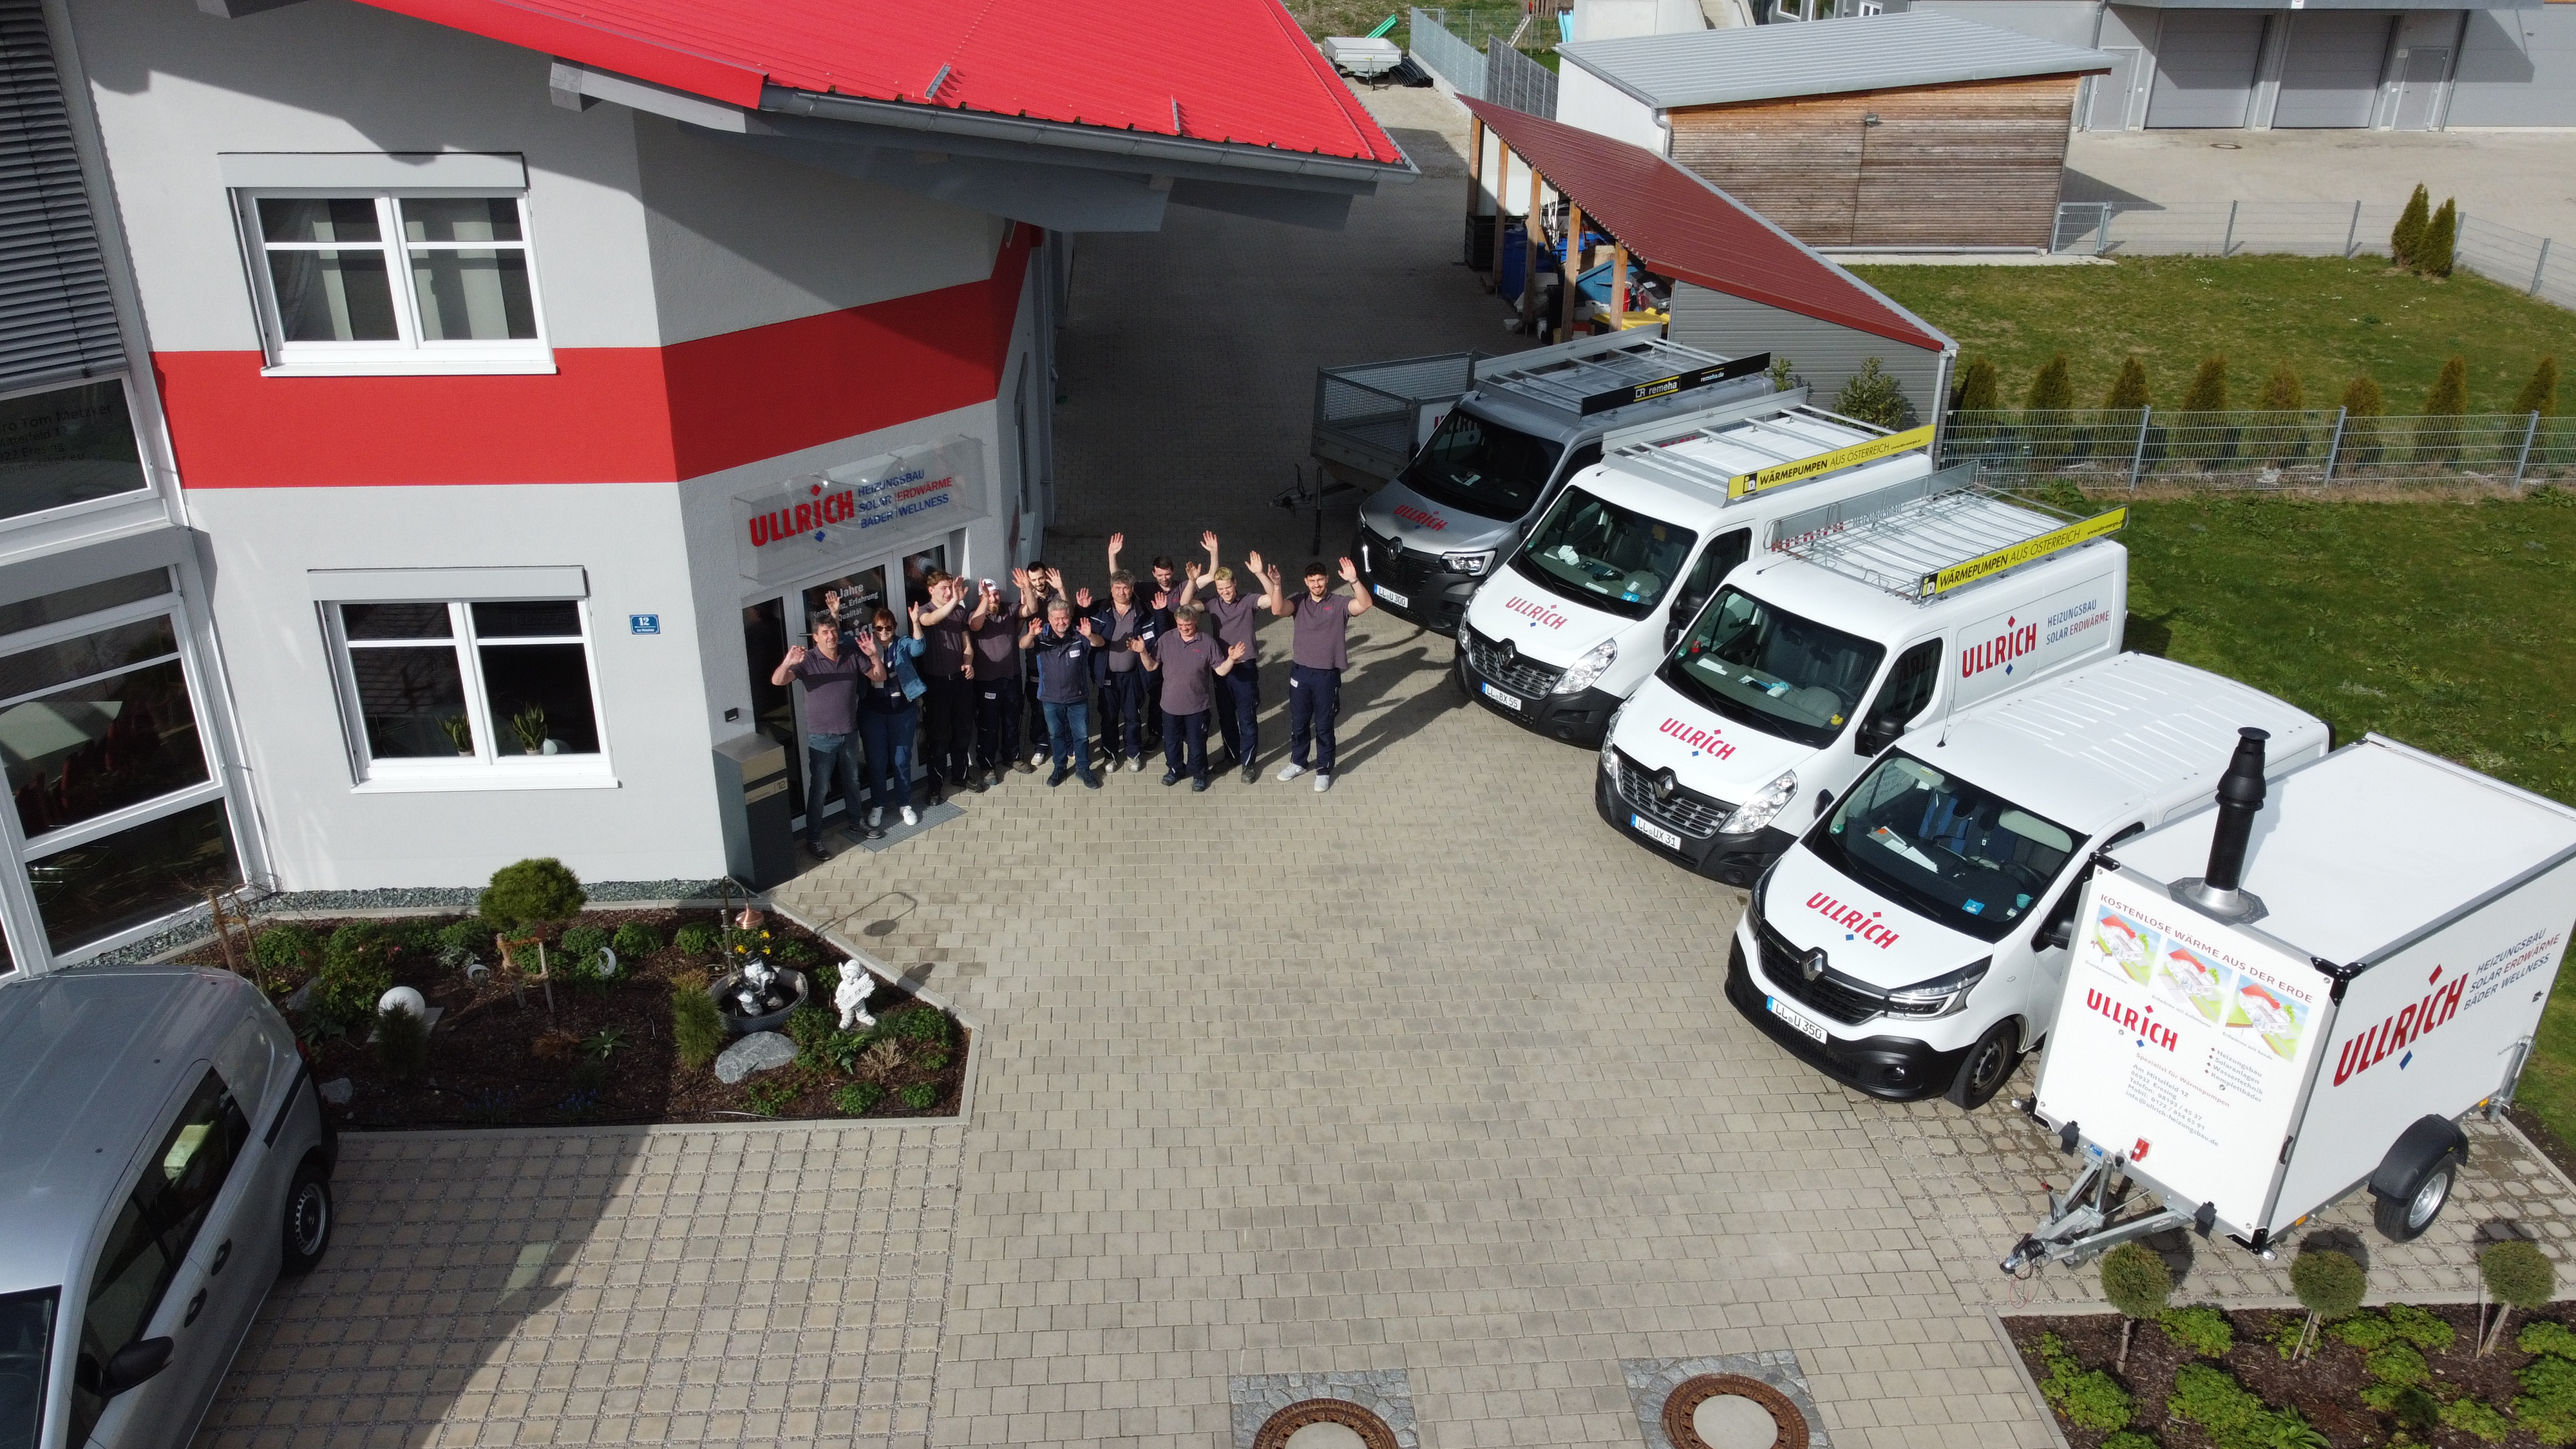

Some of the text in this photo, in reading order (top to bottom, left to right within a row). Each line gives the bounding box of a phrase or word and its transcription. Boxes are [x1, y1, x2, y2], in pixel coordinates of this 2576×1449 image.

[1649, 381, 1678, 395] remeha
[20, 417, 52, 428] Tom
[1759, 459, 1828, 486] WÄRMEPUMPEN
[1830, 455, 1845, 467] AUS
[1847, 442, 1889, 462] ÖSTERREICH
[858, 469, 925, 497] HEIZUNGSBAU
[859, 477, 952, 513] SOLAR ERDWÄRME
[898, 494, 949, 516] WELLNESS
[1940, 553, 2009, 588] WÄRMEPUMPEN
[2009, 547, 2029, 564] AUS
[2030, 528, 2081, 555] ÖSTERREICH
[840, 584, 864, 599] Jahre
[849, 592, 879, 607] Erfahrung
[1378, 587, 1386, 598] LL
[1389, 592, 1394, 601] U
[638, 617, 650, 626] 12
[838, 607, 862, 621] Qualität
[2046, 611, 2110, 645] SOLAR ERDWÄRME
[2047, 599, 2097, 628] HEIZUNGSBAU
[1486, 685, 1519, 708] LL BX 55
[1638, 819, 1676, 847] LL UX 31
[2100, 894, 2313, 1003] KOSTENLOSE WÄRME AUS DER ERDE
[2470, 933, 2561, 993] SOLAR ERDWÄRME
[2476, 928, 2546, 975] HEIZUNGSBAU
[2463, 953, 2550, 1010] BÄDER WELLNESS
[1775, 1002, 1822, 1040] LL U 350
[2215, 1057, 2260, 1084] Solaranlagen
[2217, 1050, 2262, 1077] Heizungsbau
[2133, 1064, 2188, 1098] Am Mittelfeld 12
[2136, 1052, 2230, 1108] Spezialist für Wärmepumpen
[2153, 1082, 2177, 1101] Eresing
[2211, 1072, 2262, 1103] Komplettbäder
[2213, 1065, 2263, 1095] Wassertechnik
[2125, 1090, 2219, 1146] info@ullrich-heizungsbau.de
